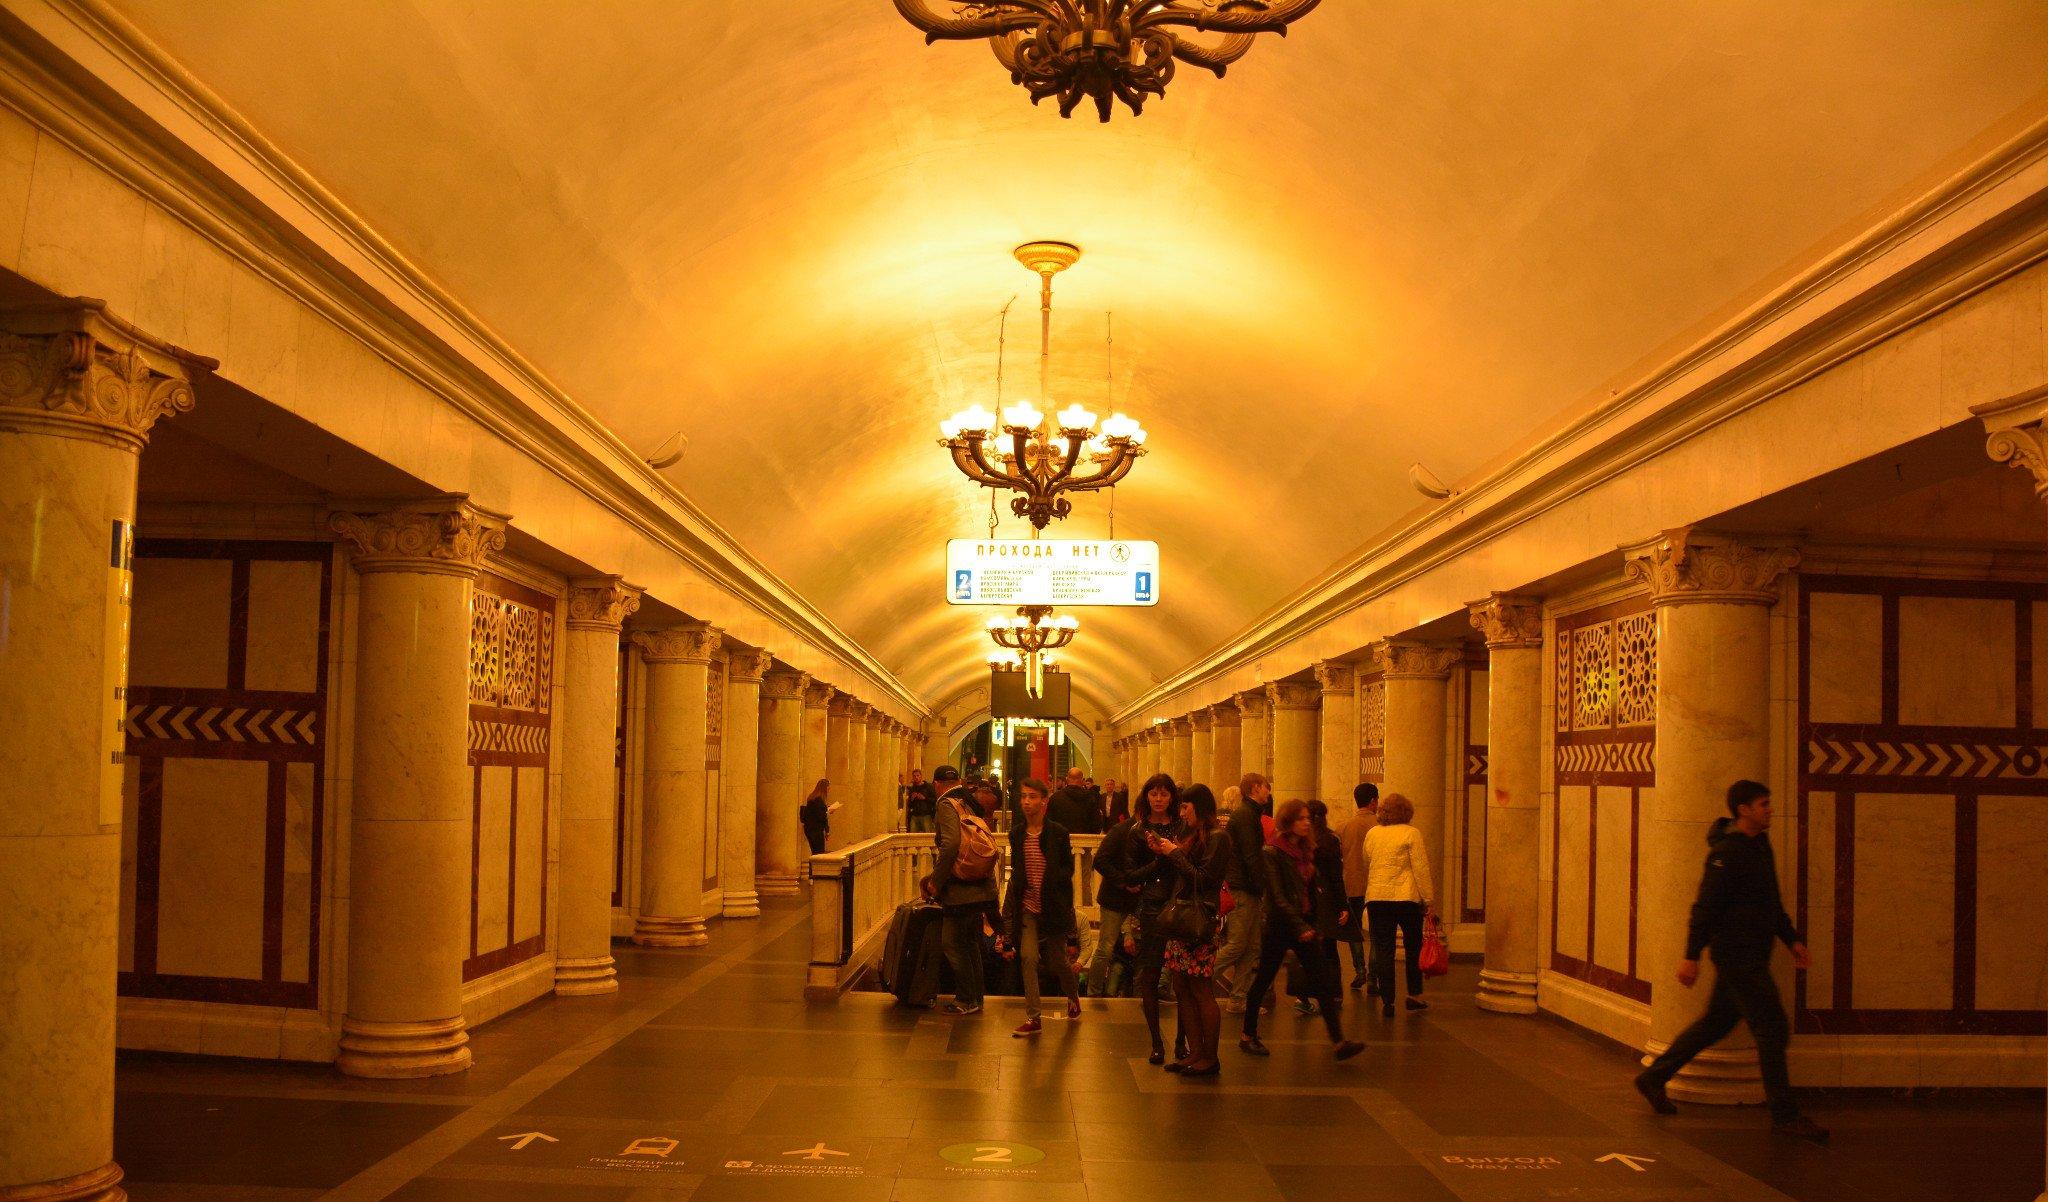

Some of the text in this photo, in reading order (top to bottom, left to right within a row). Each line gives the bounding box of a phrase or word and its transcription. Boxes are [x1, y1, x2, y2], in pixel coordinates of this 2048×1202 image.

[977, 545, 1099, 557] ПРОХОДА НЕТ
[959, 573, 969, 590] 2
[1138, 575, 1146, 590] 1
[972, 1147, 1013, 1162] 2
[1441, 1155, 1562, 1164] Выход
